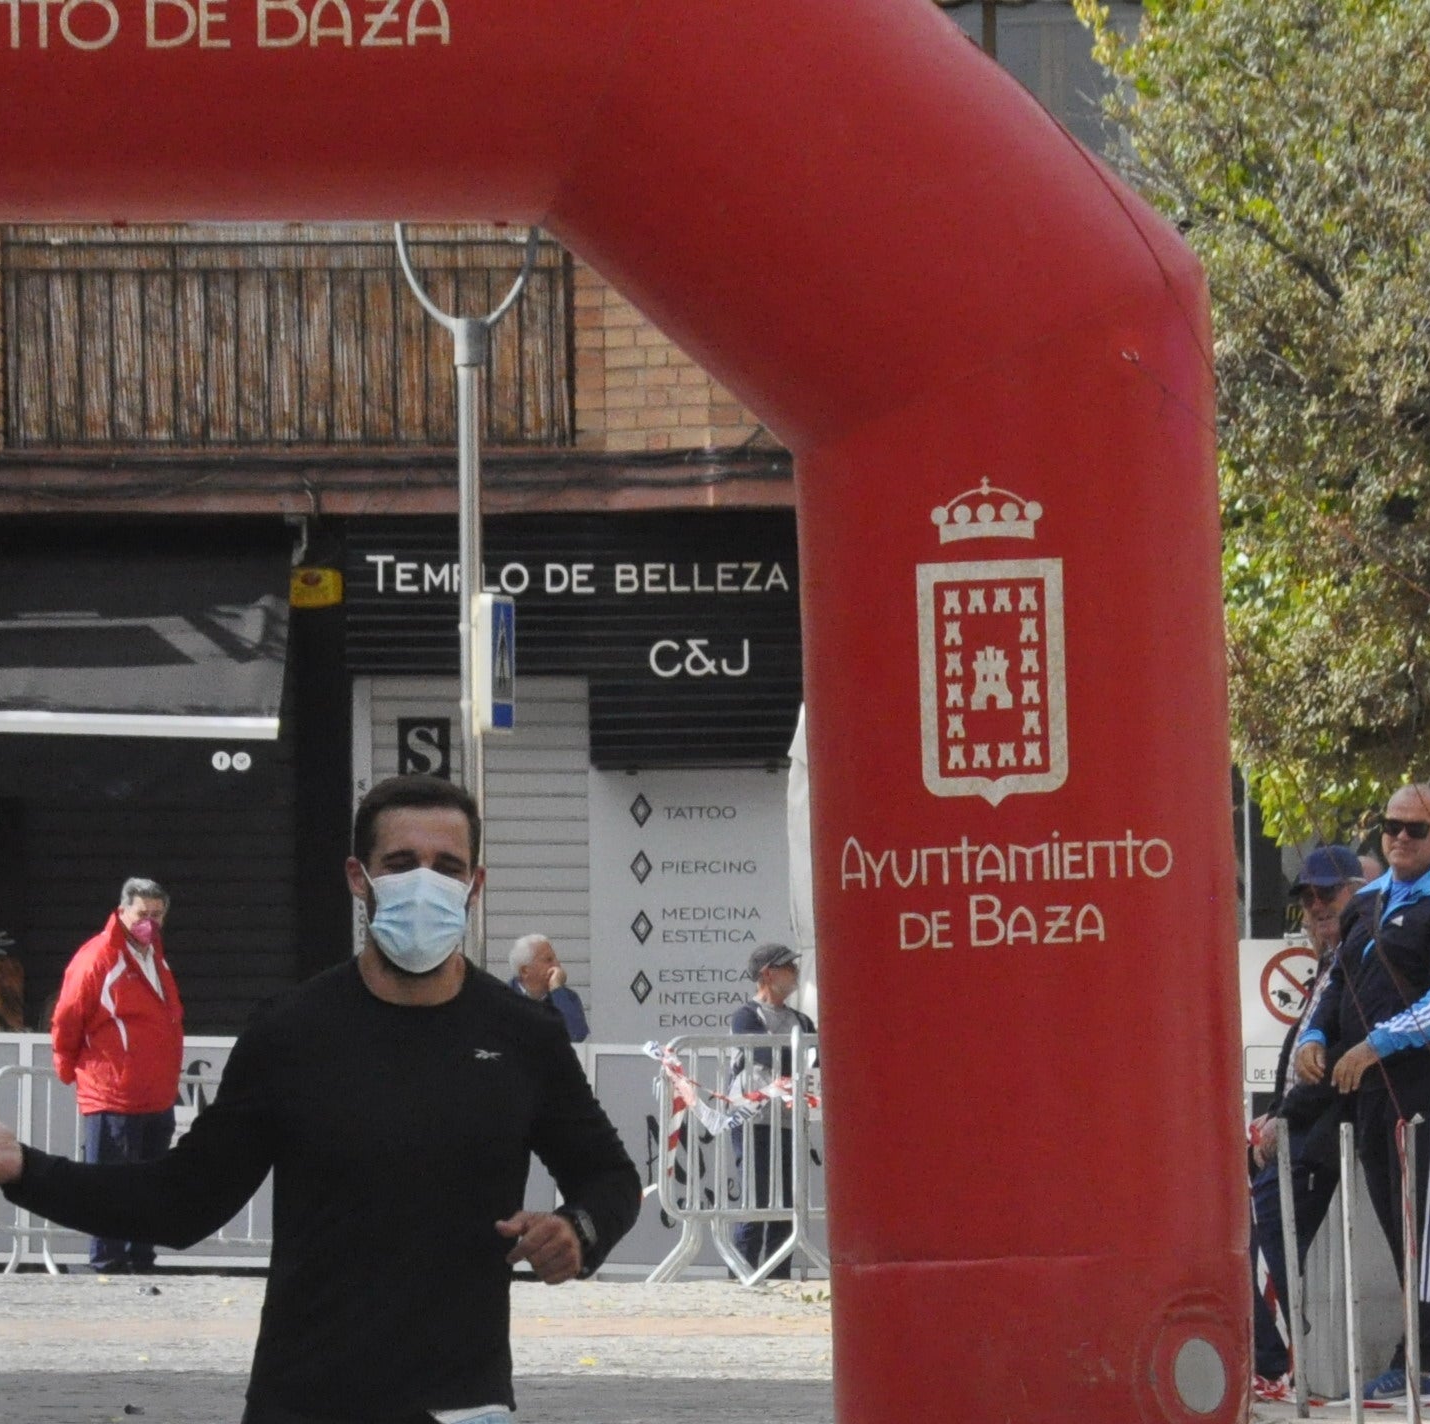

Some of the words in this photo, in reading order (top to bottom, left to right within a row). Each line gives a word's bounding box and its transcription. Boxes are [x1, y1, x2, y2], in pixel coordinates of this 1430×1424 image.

[545, 563, 595, 593] DE
[615, 563, 789, 593] BELLEZA
[649, 639, 750, 677] C&J
[663, 806, 737, 820] TATTOO
[661, 861, 757, 874] PIERCING
[662, 907, 761, 920] MEDICINA
[899, 910, 953, 950] DE
[969, 893, 1105, 947] BAZA
[662, 926, 757, 943] ESTÉTICA
[658, 966, 753, 982] ESTÉTICA
[658, 991, 753, 1005] INTEGRAL
[1253, 1068, 1266, 1080] DE
